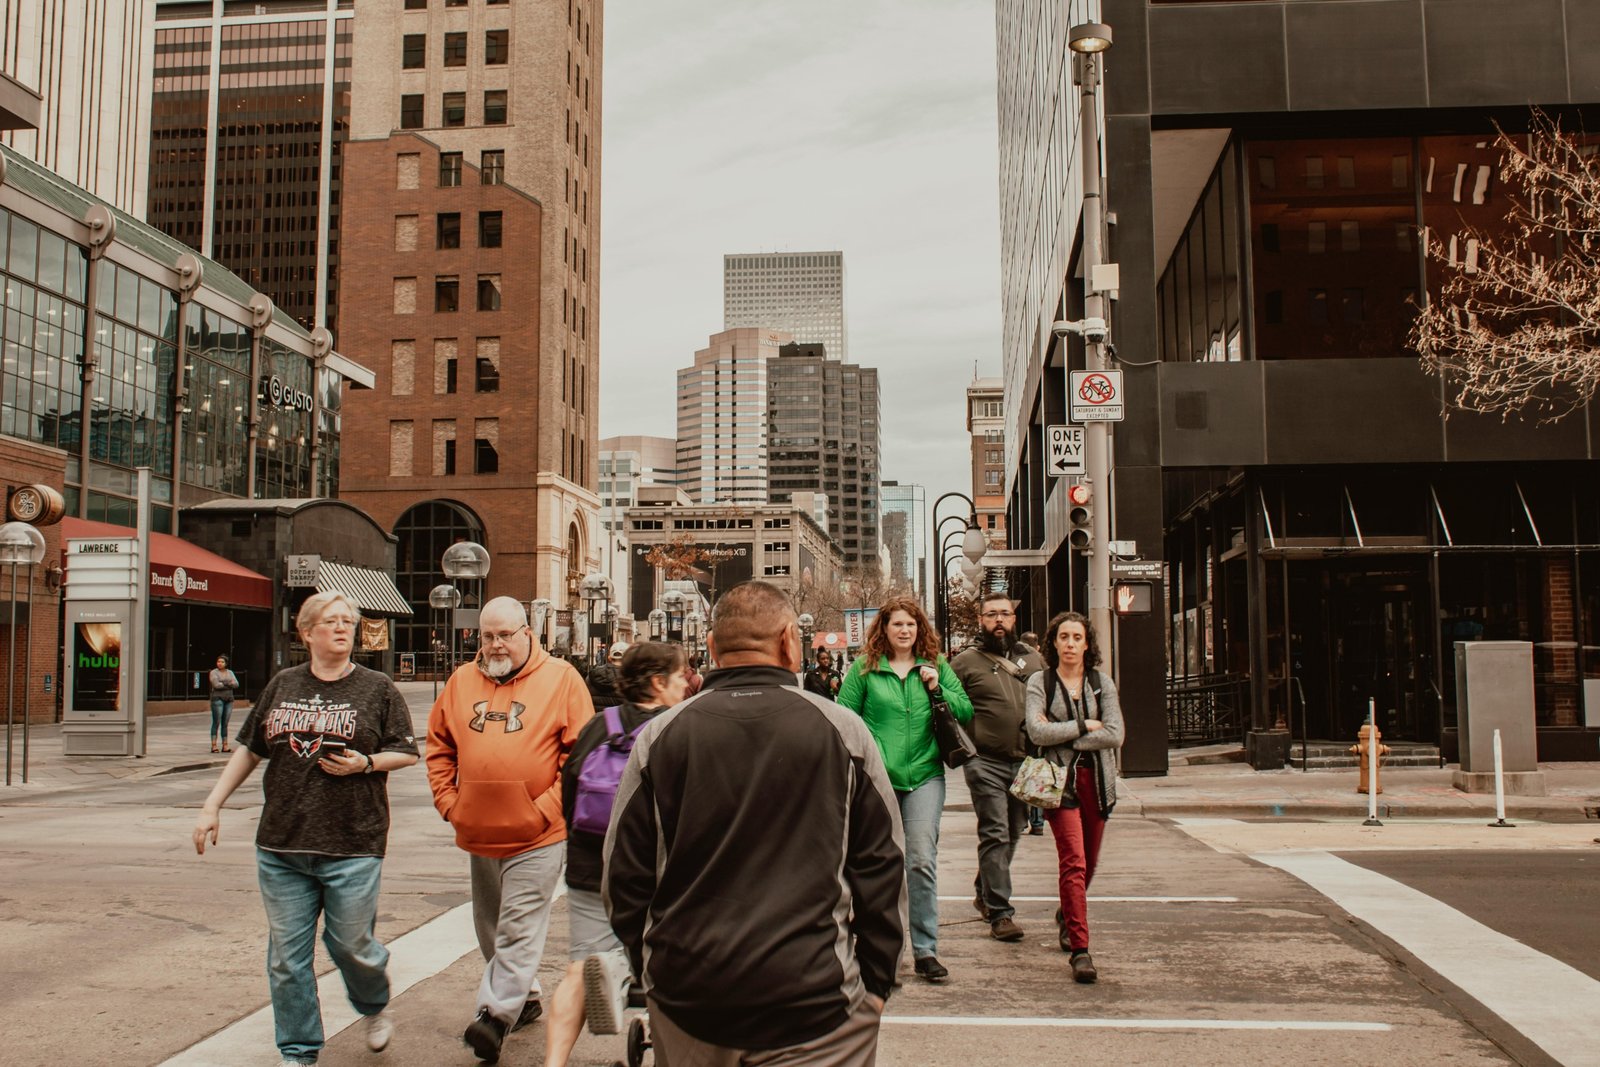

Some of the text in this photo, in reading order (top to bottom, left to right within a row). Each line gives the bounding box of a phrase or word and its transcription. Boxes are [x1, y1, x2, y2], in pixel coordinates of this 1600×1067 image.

[283, 385, 313, 412] GUSTO
[1053, 430, 1081, 442] ONE
[1052, 444, 1082, 456] WAY
[79, 543, 119, 554] LAWRENCE
[1112, 563, 1155, 572] Lawrence
[151, 572, 173, 587] Burnt
[186, 576, 208, 591] Barrel
[290, 574, 316, 582] bakery
[850, 611, 859, 643] DENVER
[79, 652, 120, 668] hulu
[280, 701, 325, 712] STANLEY
[327, 703, 351, 711] CUP
